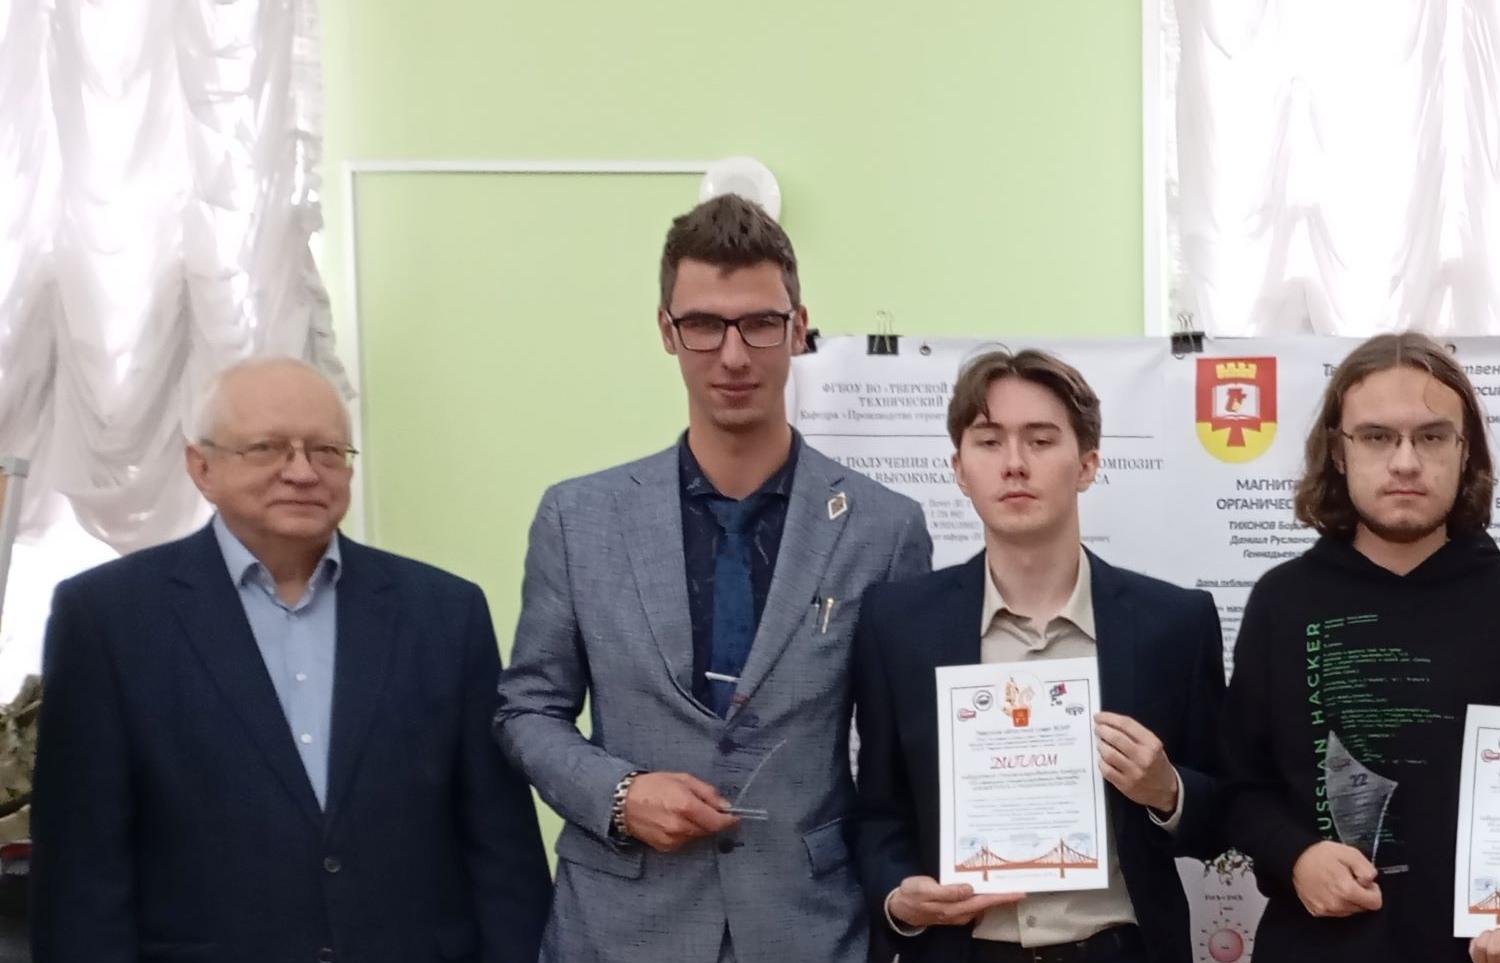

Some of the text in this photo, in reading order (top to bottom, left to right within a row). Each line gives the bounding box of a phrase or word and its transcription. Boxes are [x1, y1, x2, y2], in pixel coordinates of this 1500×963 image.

[1097, 458, 1164, 470] ОМПОЗИТ
[1236, 479, 1294, 491] МАГНИТ
[1216, 498, 1293, 510] ОРГАНИЧЕС
[1306, 622, 1326, 725] HACKER
[1314, 738, 1334, 838] USSIAN
